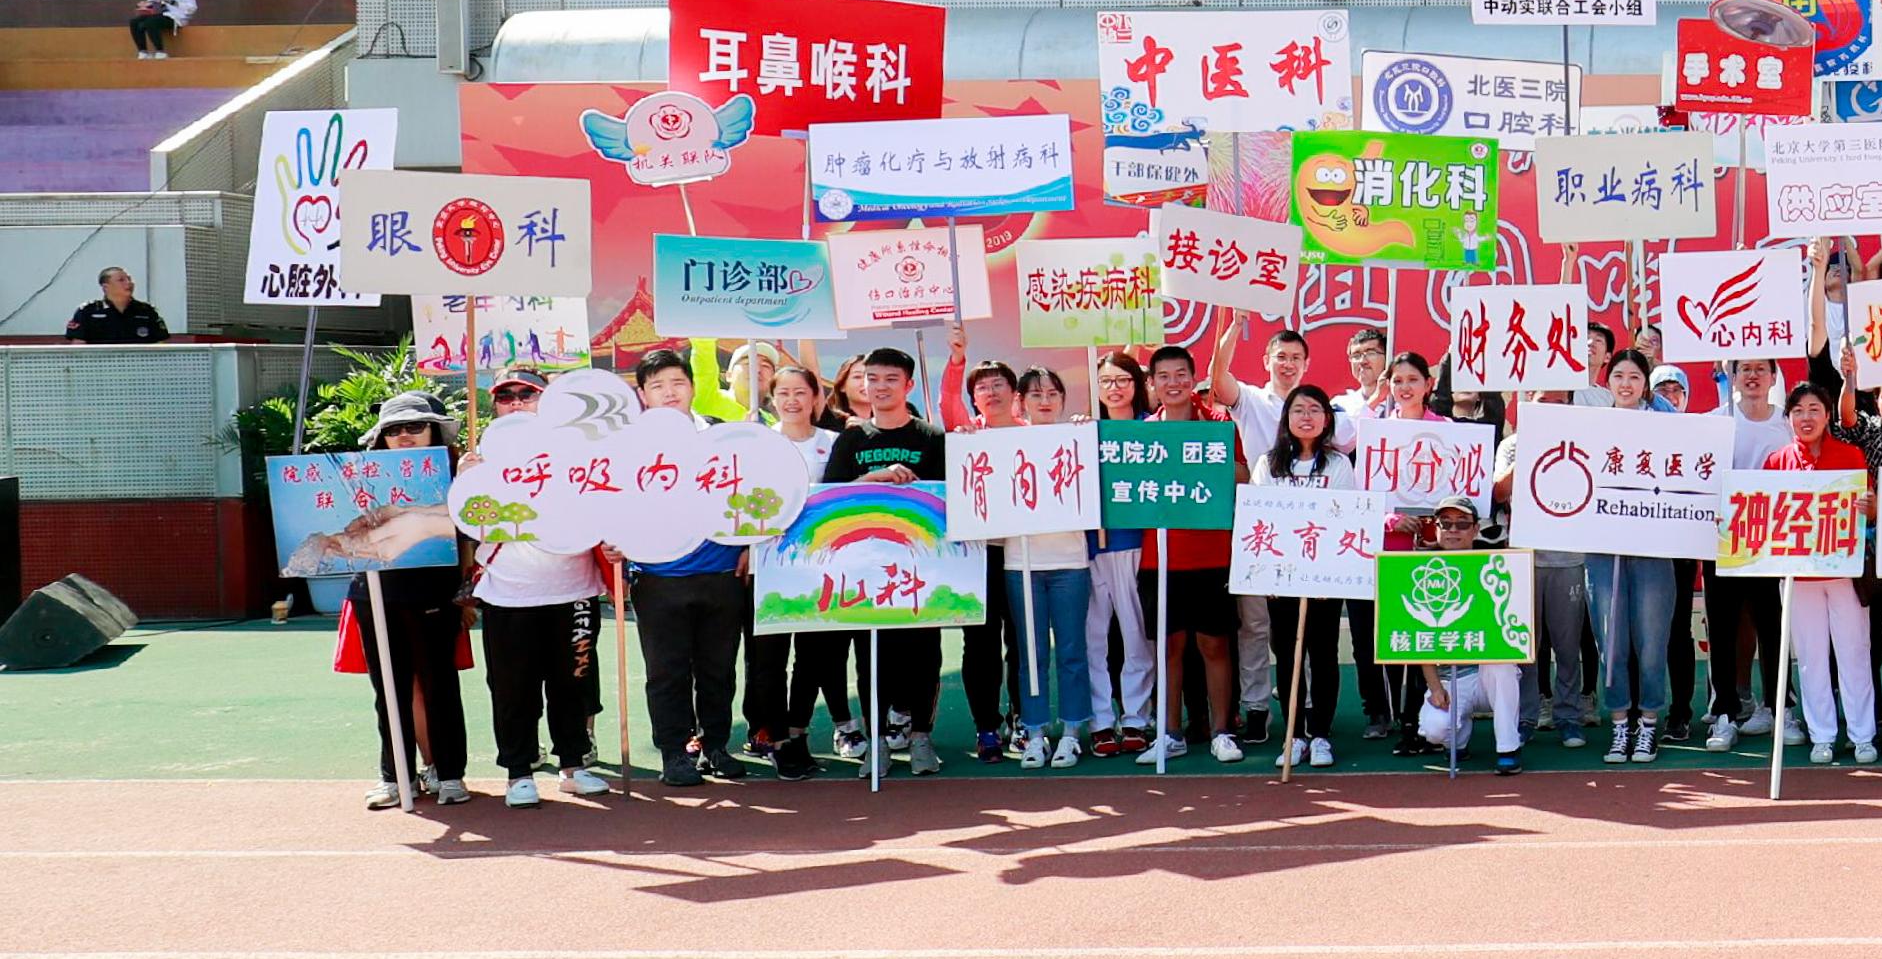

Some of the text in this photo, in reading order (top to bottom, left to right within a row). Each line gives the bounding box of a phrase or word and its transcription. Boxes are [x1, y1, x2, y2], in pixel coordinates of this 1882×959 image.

[700, 28, 911, 105] 耳鼻喉科
[1125, 36, 1331, 107] 中医科
[1467, 74, 1568, 102] 北医三院
[1464, 111, 1576, 136] 口腔科
[824, 142, 1061, 178] 肿瘤化疗与放射病科
[1352, 157, 1488, 212] 消化科
[1555, 157, 1704, 212] 职业病科
[683, 259, 788, 294] 门诊部
[1163, 228, 1288, 291] 接诊室
[261, 263, 362, 300] 心脏外
[1027, 266, 1156, 313] 感染疾病科
[1457, 299, 1586, 385] 财务处
[1711, 320, 1794, 348] 心内科
[1099, 440, 1228, 464] 党院办 团委
[1365, 437, 1486, 497] 内分泌
[1600, 446, 1716, 481] 康复医学
[502, 453, 743, 497] 呼吸内科
[962, 438, 1087, 522] 肾内科
[1111, 480, 1212, 504] 宣传中心
[316, 486, 413, 509] 联合队
[1596, 498, 1716, 522] Rehabilitation
[1241, 519, 1376, 562] 教育处
[1728, 491, 1858, 559] 神经科
[817, 562, 926, 617] 儿科
[1390, 630, 1486, 653] 核医学科
